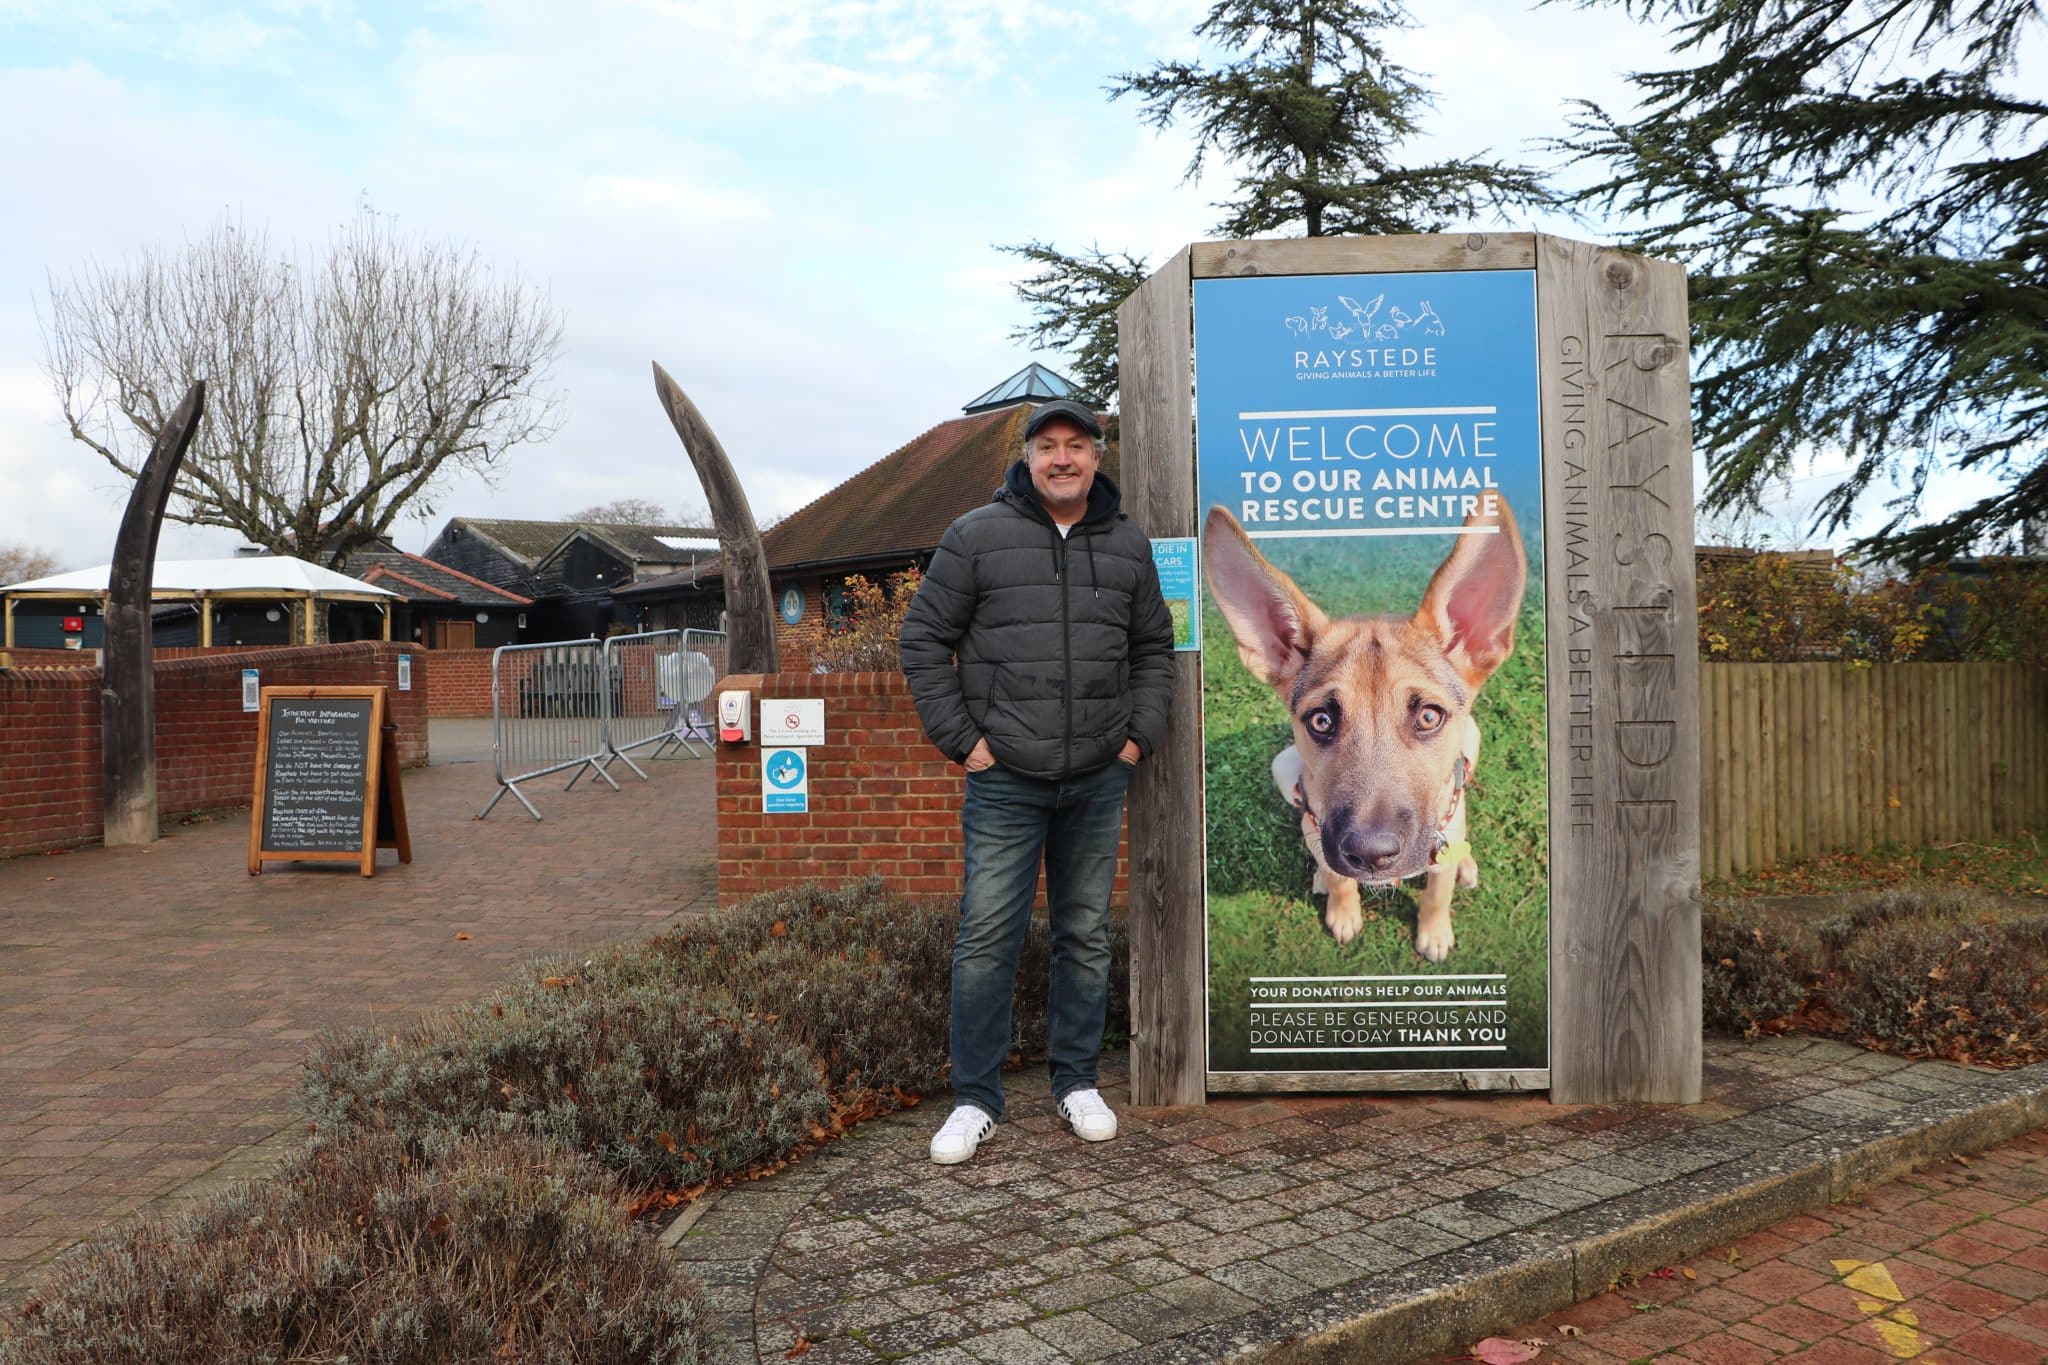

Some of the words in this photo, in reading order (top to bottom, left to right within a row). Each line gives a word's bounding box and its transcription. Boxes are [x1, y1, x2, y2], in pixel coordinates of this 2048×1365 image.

[1295, 347, 1437, 369] RAYSTEDE
[1296, 372, 1330, 380] GIVING
[1331, 370, 1372, 379] ANIMALS
[1374, 370, 1381, 378] A
[1383, 369, 1416, 378] BETTER
[1418, 369, 1437, 377] LIFE
[1560, 335, 1586, 450] GIVING
[1239, 422, 1498, 463] WELCOME
[1240, 471, 1283, 495] TO
[1292, 468, 1362, 493] OUR
[1372, 465, 1499, 491] ANIMAL
[1242, 497, 1369, 523] RESCUE
[1375, 493, 1500, 519] CENTRE
[1564, 460, 1591, 604] ANIMALS
[1156, 557, 1183, 566] CARS
[1158, 545, 1175, 554] DIE
[1176, 544, 1188, 553] IN
[1604, 333, 1677, 837] RAYSTEDE
[1568, 614, 1591, 637] A
[1568, 648, 1593, 763] BETTER
[1570, 775, 1594, 839] LIFE
[1250, 986, 1288, 998] YOUR
[1292, 985, 1372, 998] DONATIONS
[1376, 985, 1411, 997] HELP
[1413, 984, 1443, 996] OUR
[1446, 984, 1507, 996] ANIMALS
[1250, 1011, 1317, 1027] PLEASE
[1324, 1011, 1347, 1026] BE
[1353, 1010, 1459, 1025] GENEROUS
[1465, 1010, 1506, 1025] AND
[1250, 1029, 1325, 1044] DONATE
[1332, 1029, 1393, 1043] TODAY
[1397, 1027, 1462, 1043] THANK
[1467, 1027, 1507, 1042] YOU
